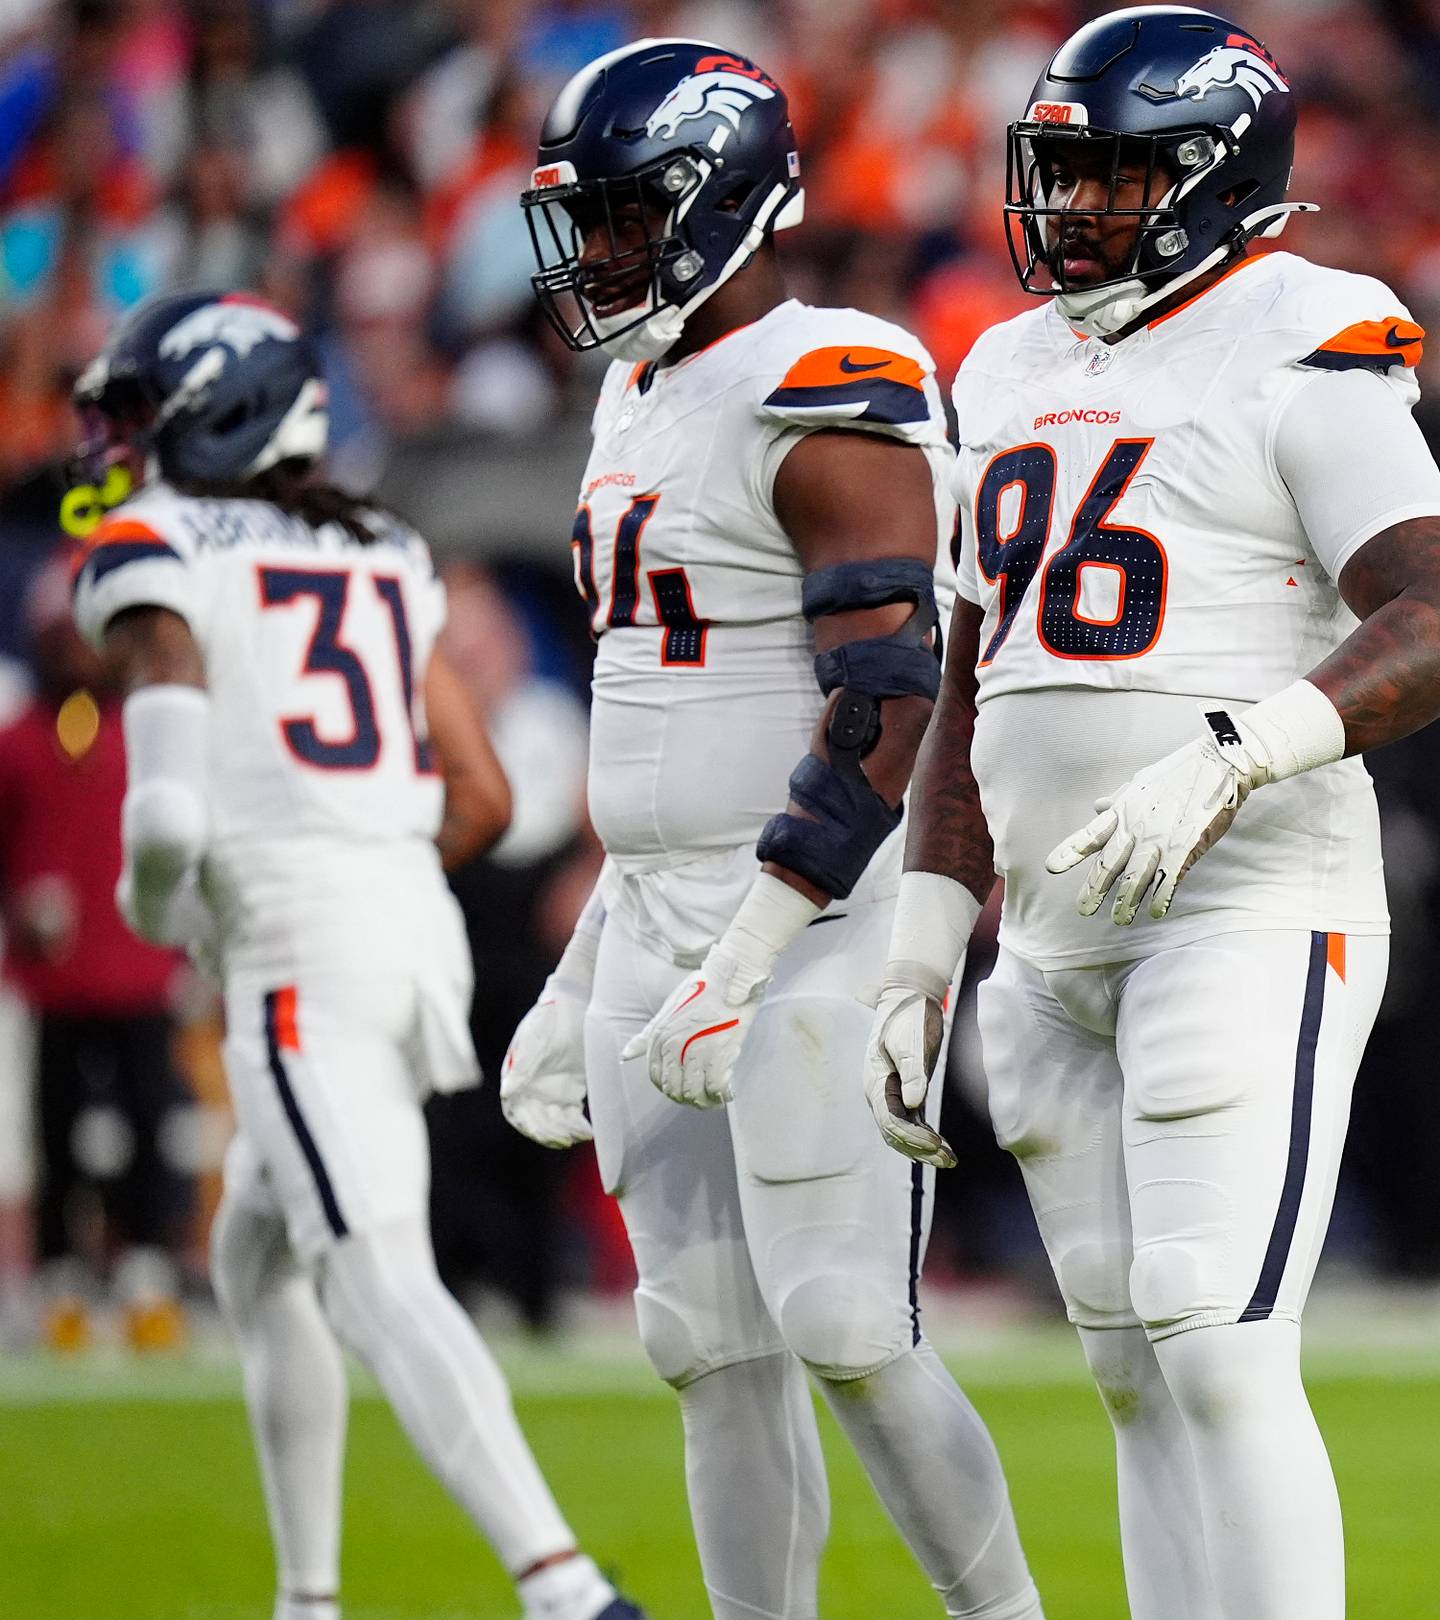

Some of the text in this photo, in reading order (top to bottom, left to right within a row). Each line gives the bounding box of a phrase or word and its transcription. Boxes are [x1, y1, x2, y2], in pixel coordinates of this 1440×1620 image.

[1033, 104, 1072, 124] 5280
[1033, 408, 1121, 430] BRONCOS
[974, 437, 1168, 669] 96
[254, 565, 444, 776] 31
